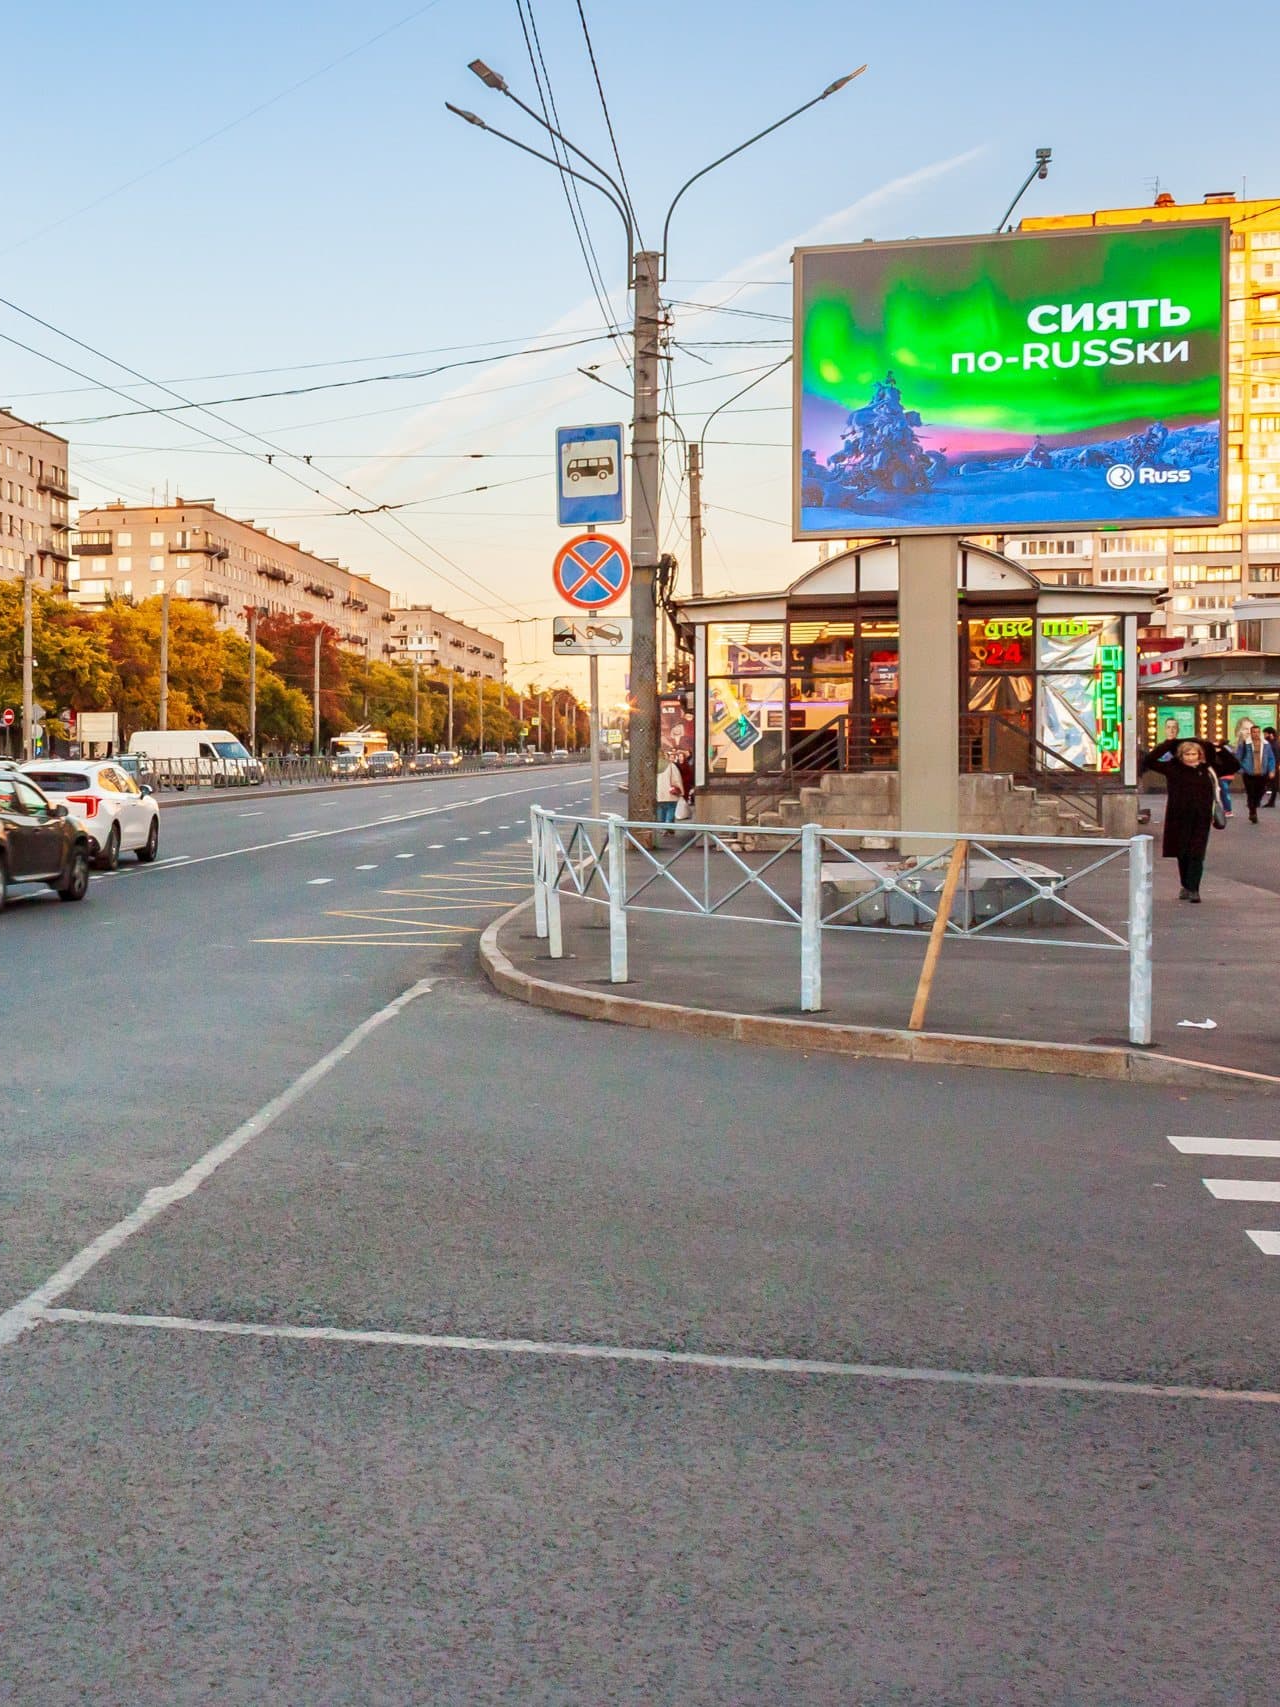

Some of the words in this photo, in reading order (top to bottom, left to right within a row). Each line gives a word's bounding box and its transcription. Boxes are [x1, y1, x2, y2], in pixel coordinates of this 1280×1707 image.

[952, 338, 1189, 374] по-RUSSки
[738, 647, 805, 666] pdat.
[985, 643, 1023, 665] 24
